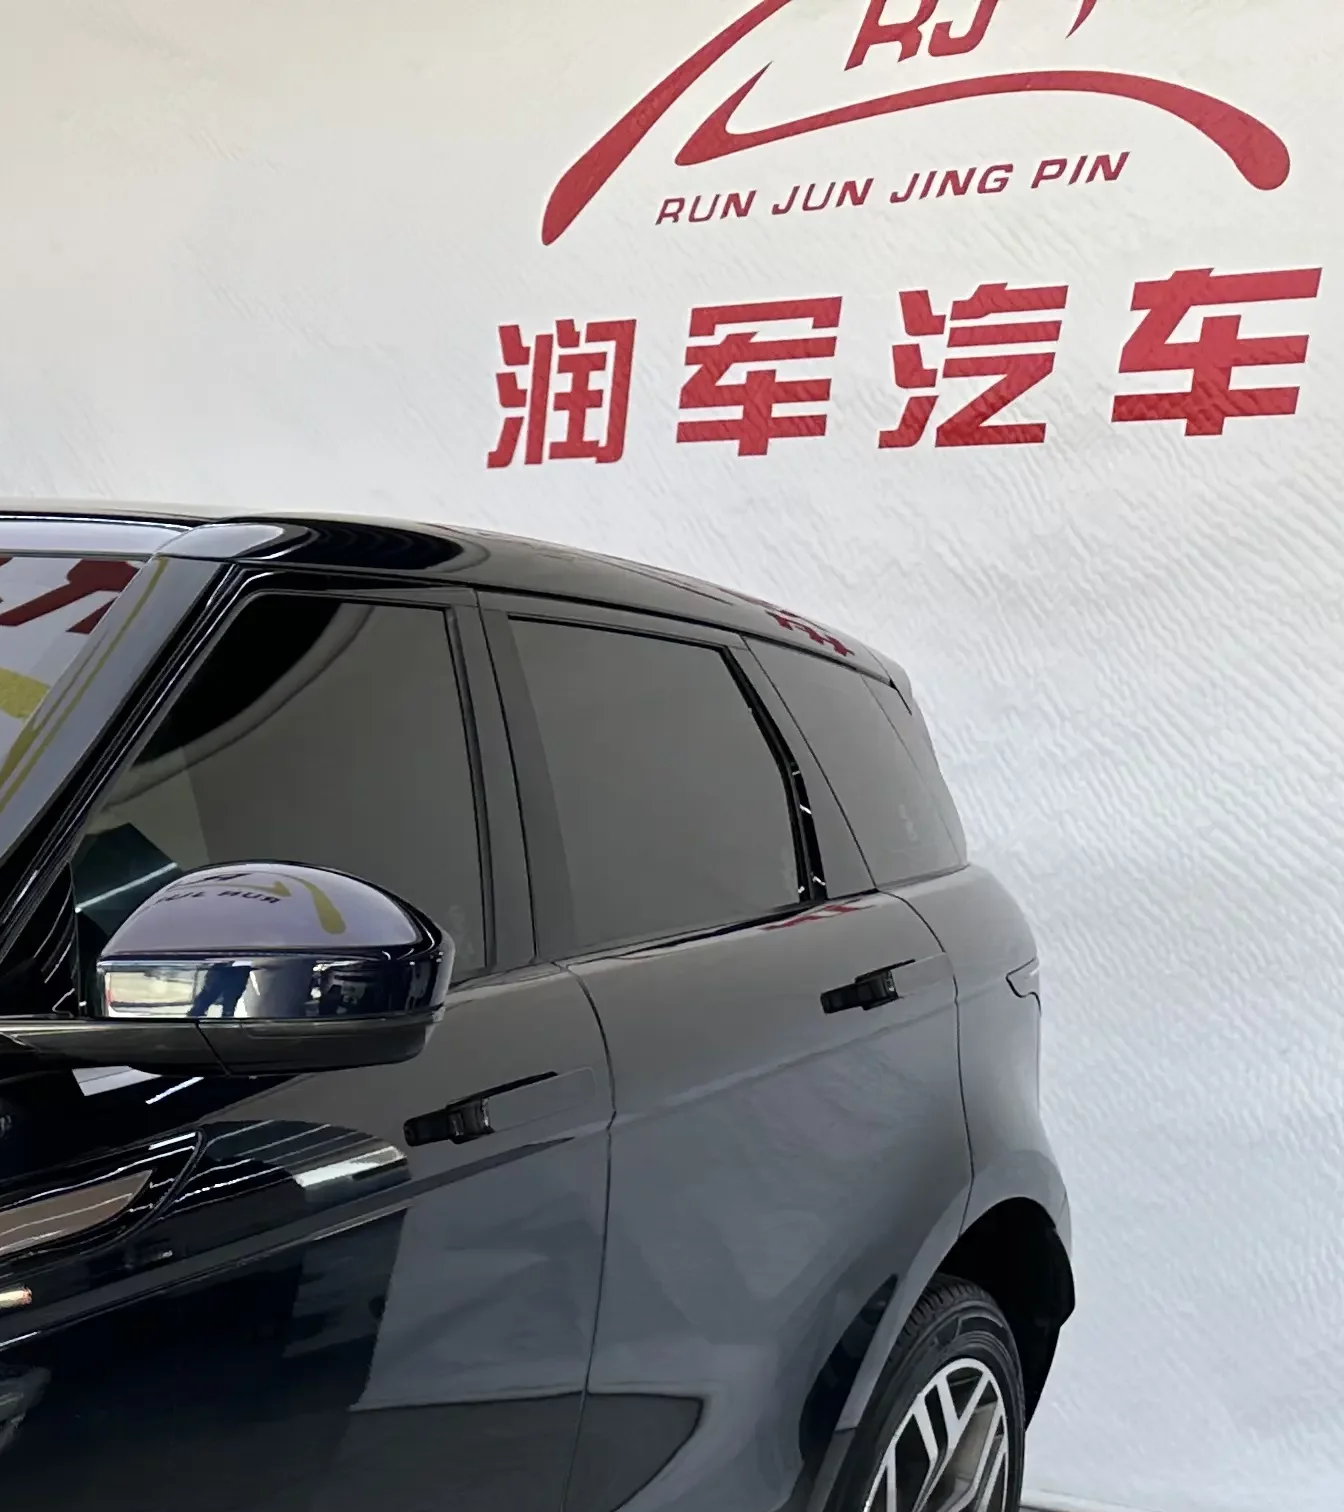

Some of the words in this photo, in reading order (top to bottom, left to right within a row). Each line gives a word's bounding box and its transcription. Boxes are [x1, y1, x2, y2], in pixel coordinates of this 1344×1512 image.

[655, 189, 757, 225] RUN
[771, 177, 874, 215] JUN
[889, 163, 1014, 204] JING
[1031, 151, 1130, 189] PIN
[486, 267, 1323, 468] 润军汽车
